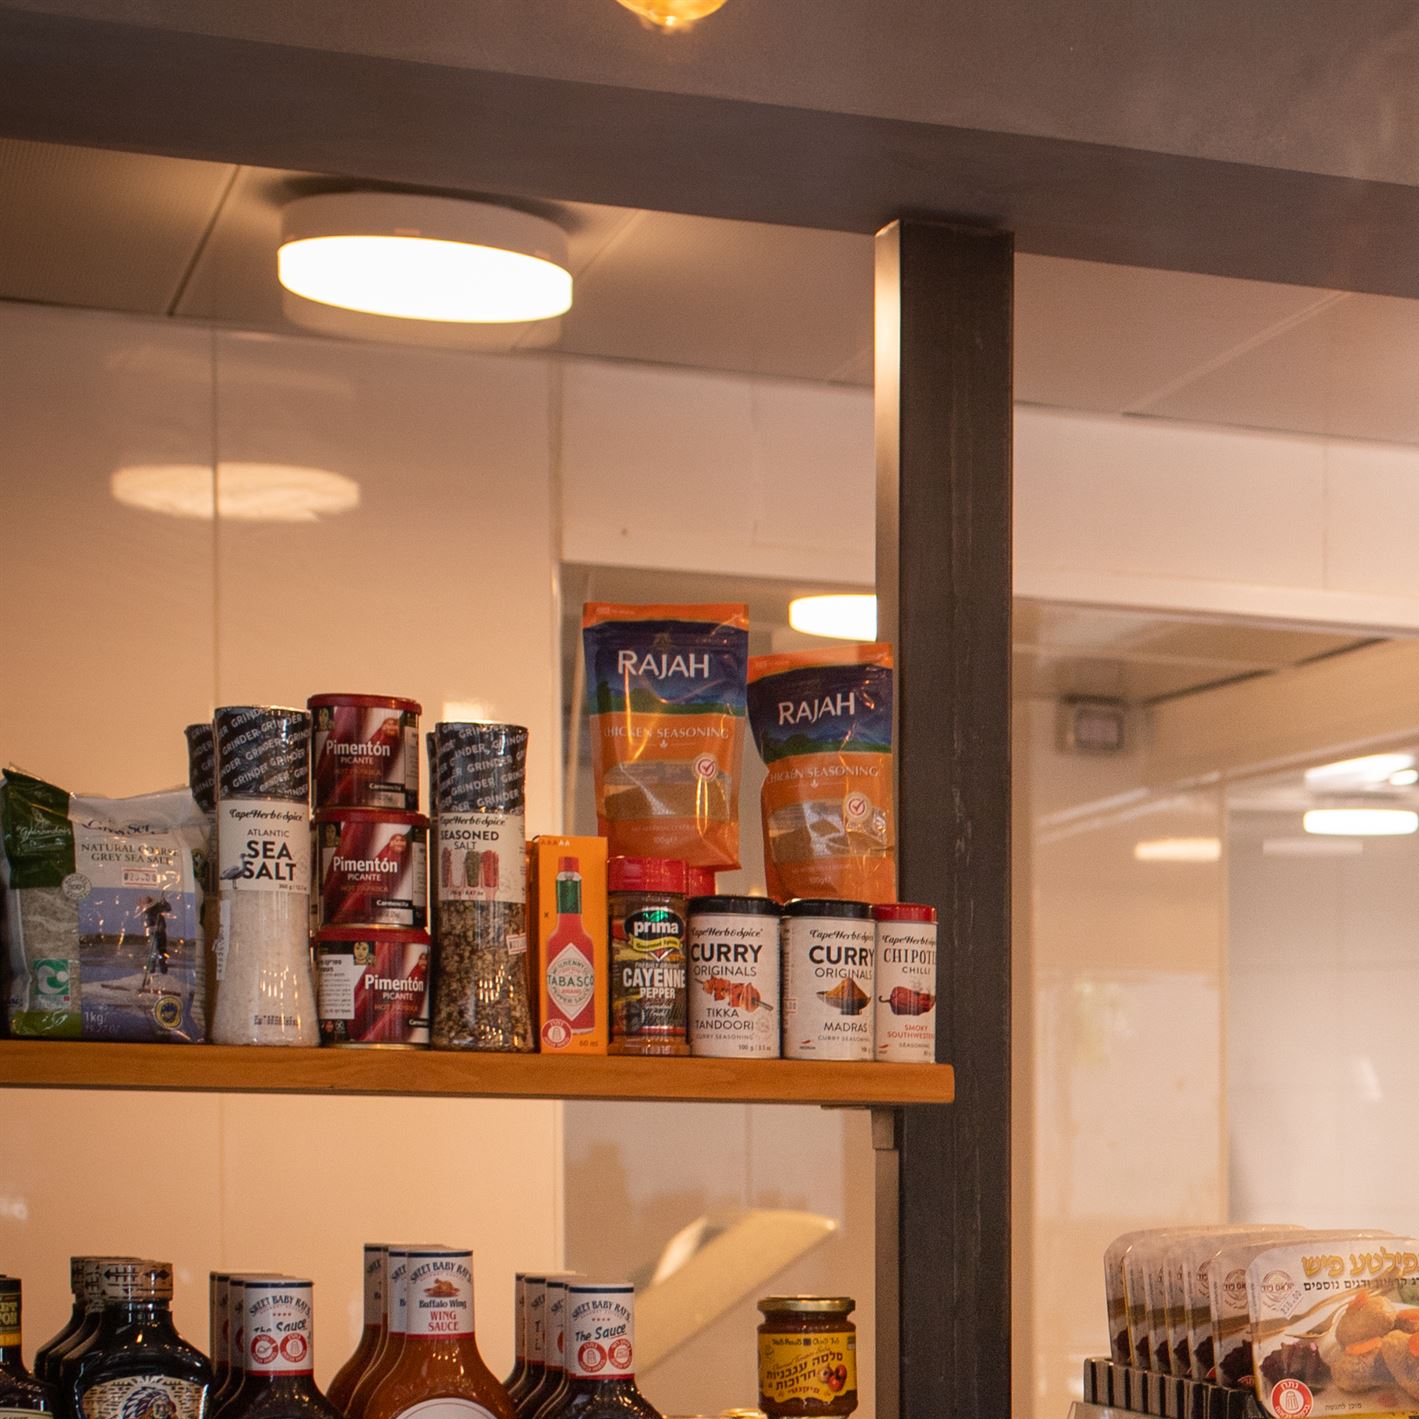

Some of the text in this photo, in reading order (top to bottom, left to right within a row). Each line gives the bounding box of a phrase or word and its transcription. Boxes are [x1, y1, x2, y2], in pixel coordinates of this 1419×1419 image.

[617, 649, 710, 680] RAJAH
[778, 692, 856, 726] RAJAH
[657, 725, 729, 740] SEASONING
[325, 740, 392, 759] Pimentón
[340, 756, 375, 766] PICANTE
[806, 764, 880, 780] SEASONING
[247, 828, 291, 839] ATLANTIC
[440, 829, 500, 842] SEASONED
[81, 842, 136, 854] NATURAL
[246, 840, 293, 861] SEA
[453, 841, 477, 851] SALT
[90, 852, 122, 863] GREY
[123, 852, 146, 865] SEA
[242, 860, 298, 882] SALT
[333, 856, 399, 875] Pimentón
[347, 872, 382, 882] PICANTE
[633, 919, 680, 936] prima
[690, 943, 763, 964] CURRY
[808, 944, 875, 967] CURRY
[693, 964, 758, 977] ORIGINALS
[814, 967, 873, 980] ORIGINALS
[364, 973, 425, 992] Pimentón
[547, 974, 595, 988] TABASCO
[622, 967, 686, 989] CAYENNE
[381, 991, 414, 1001] PICANTE
[639, 987, 676, 1000] PEPPER
[706, 1007, 740, 1018] TIKKA
[695, 1019, 755, 1032] TANDOORI
[823, 1021, 868, 1033] MADRAS
[904, 1023, 929, 1032] SMOKY
[1301, 1252, 1345, 1278] פיש
[409, 1263, 432, 1284] SWEET
[433, 1260, 455, 1272] BABY
[1303, 1279, 1340, 1292] נוספים
[1343, 1279, 1371, 1290] ודגים
[249, 1295, 271, 1317] SWEET
[271, 1295, 294, 1305] BABY
[418, 1299, 468, 1311] Buffalo Wing
[571, 1301, 591, 1320] SWEET
[591, 1300, 612, 1310] BABY
[429, 1310, 457, 1321] WING
[427, 1320, 460, 1332] SAUCE
[575, 1323, 627, 1343] The Sauce
[812, 1350, 844, 1366] סלסה
